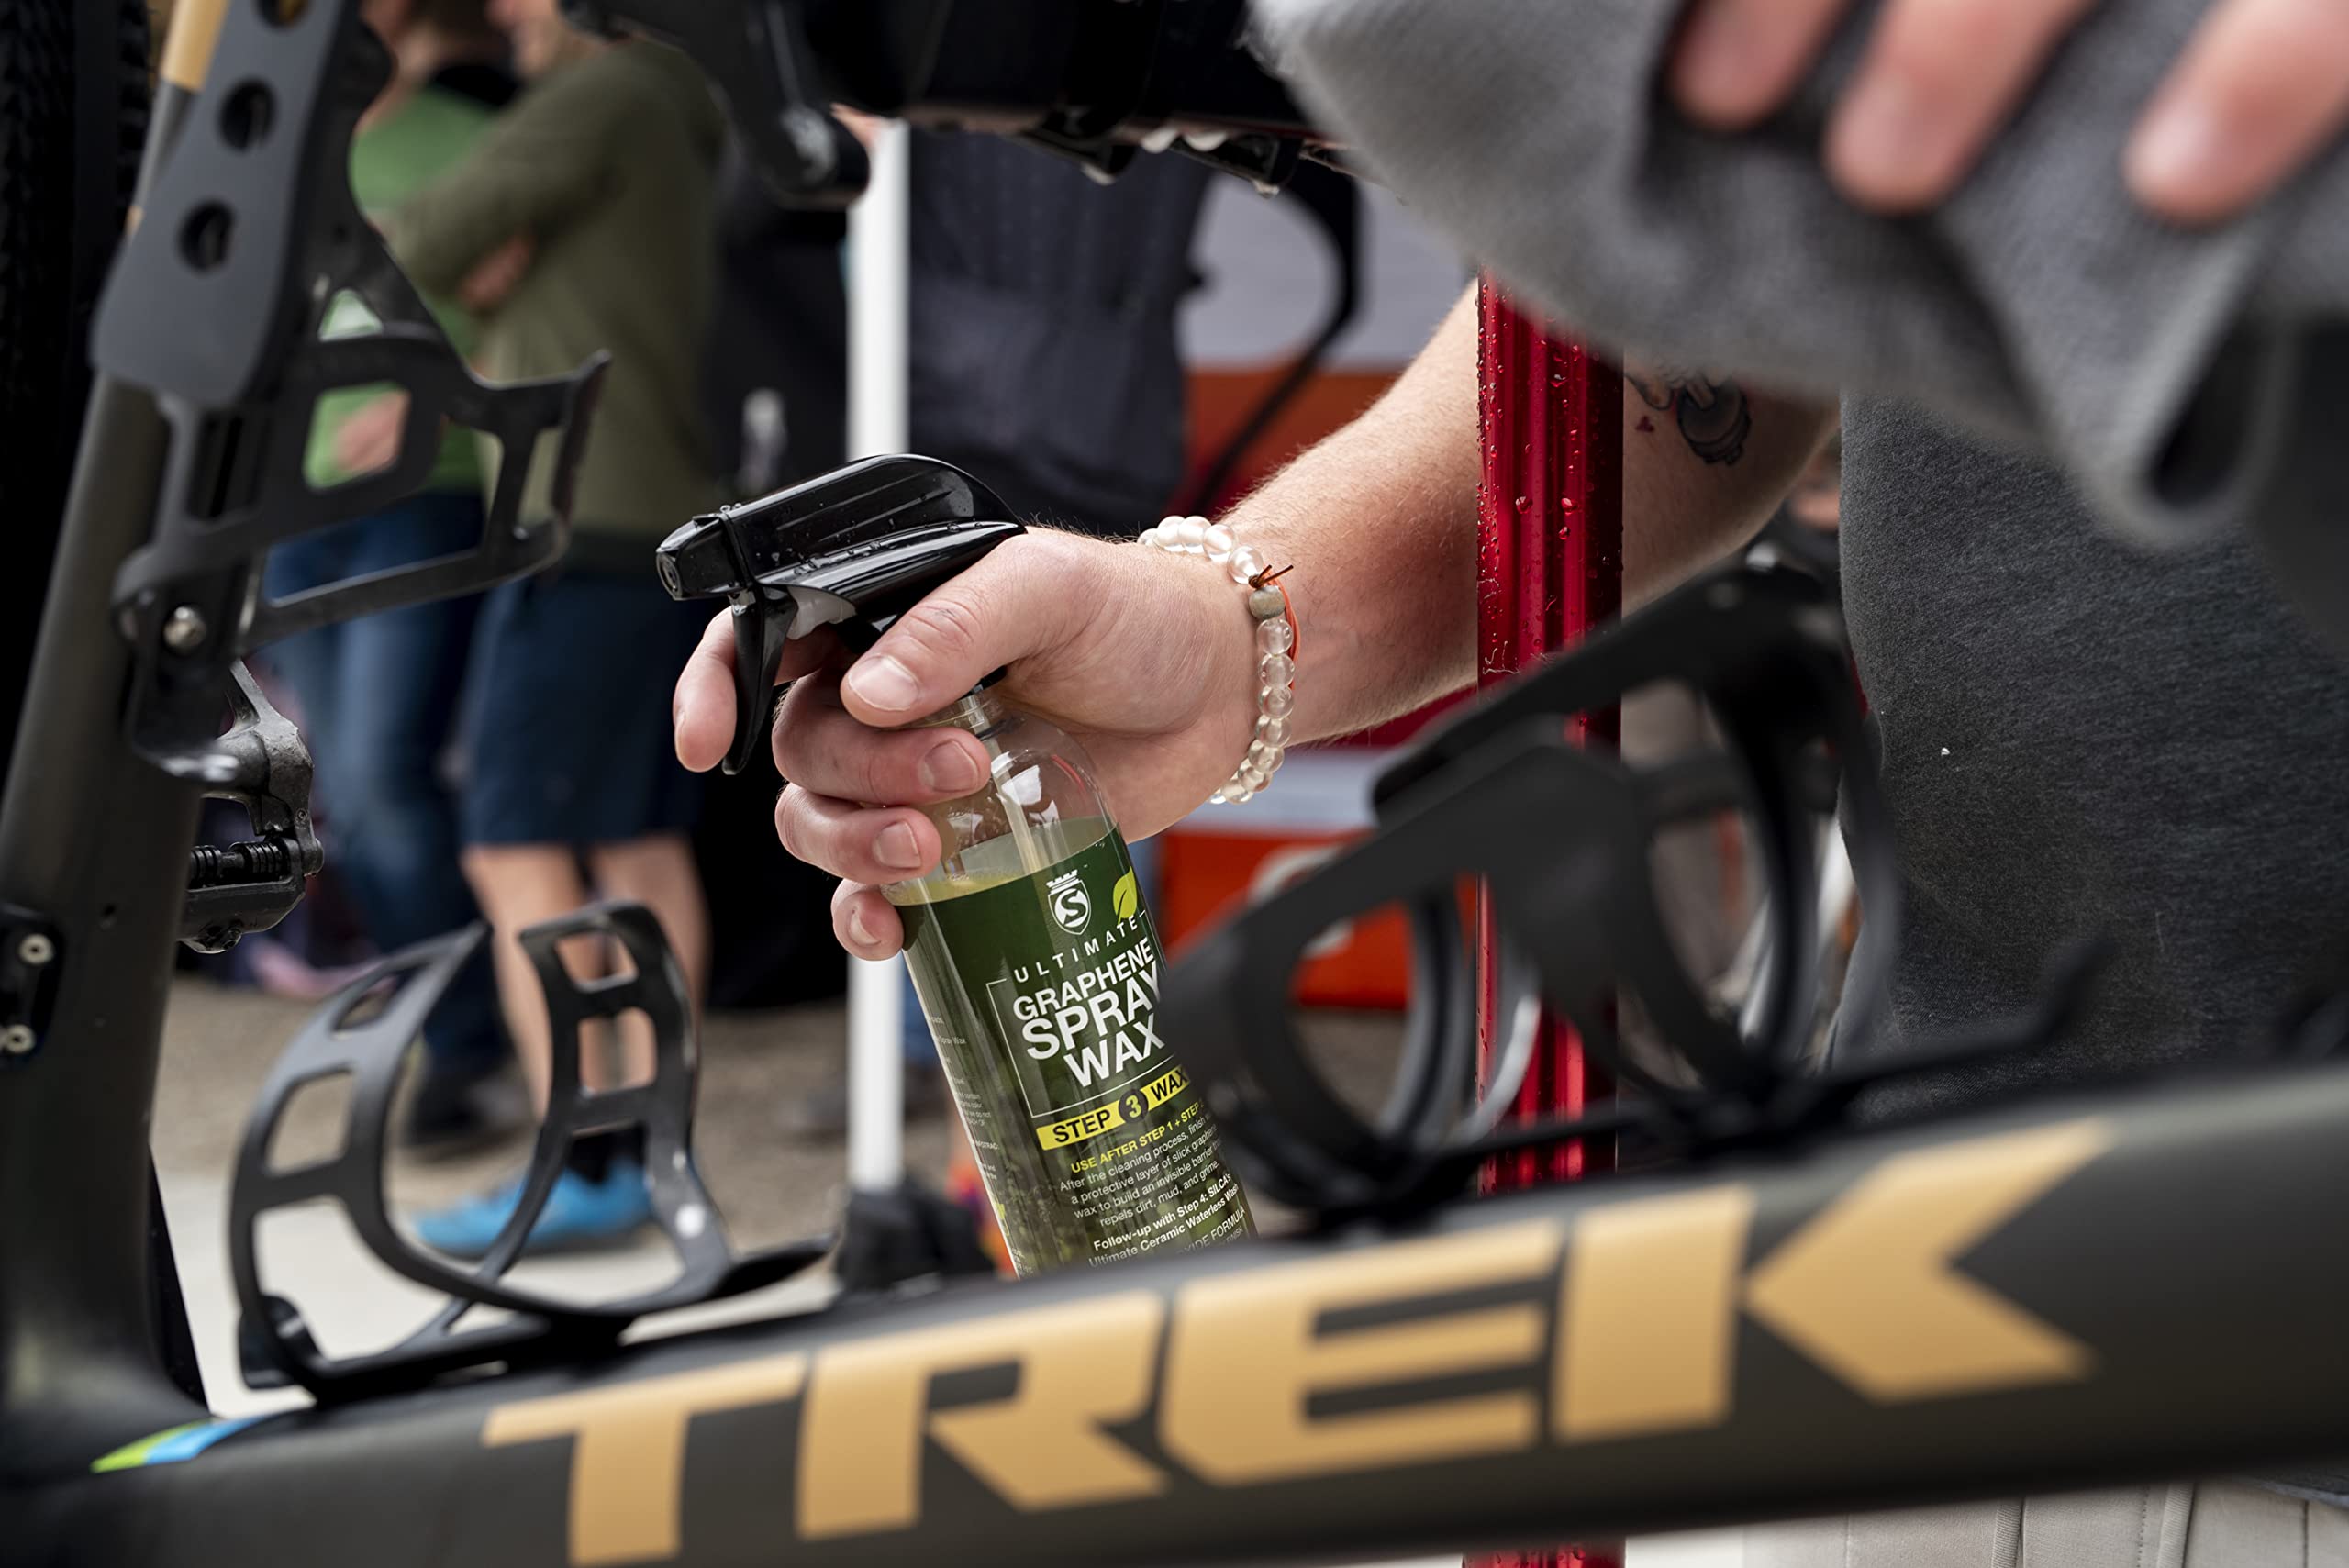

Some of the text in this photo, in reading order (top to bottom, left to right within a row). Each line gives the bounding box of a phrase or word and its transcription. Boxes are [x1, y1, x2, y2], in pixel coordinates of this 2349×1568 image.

[1013, 937, 1154, 1021] GRAPHENE
[1014, 915, 1138, 983] ULTIMATE
[1022, 960, 1160, 1060] SPRAY
[1063, 1012, 1165, 1087] WAX
[1052, 1067, 1188, 1143] STEP 3 WAX
[1071, 1157, 1097, 1173] USE
[1100, 1140, 1138, 1164] AFTER
[1139, 1126, 1165, 1147] STEP
[1167, 1121, 1173, 1131] 1
[1181, 1102, 1199, 1123] STEP
[1060, 1178, 1085, 1192] After
[1087, 1172, 1106, 1184] the
[1108, 1151, 1152, 1176] cleaning
[1152, 1131, 1189, 1159] process,
[1188, 1116, 1206, 1135] finish
[1071, 1195, 1079, 1205] a
[1081, 1176, 1134, 1204] protective
[1135, 1162, 1160, 1182] layer
[1162, 1156, 1171, 1169] of
[1173, 1145, 1191, 1162] slick
[1074, 1207, 1097, 1218] wax
[1099, 1202, 1111, 1211] to
[1113, 1188, 1141, 1207] build
[1142, 1183, 1155, 1195] an
[1157, 1162, 1192, 1187] invisible
[1191, 1145, 1214, 1167] barrier
[1088, 1246, 1139, 1267] Ultimate
[1140, 1225, 1186, 1251] Ceramic
[1186, 1197, 1225, 1229] Waterless
[1224, 1183, 1239, 1201] Wash
[1094, 1225, 1152, 1251] Follow-up
[1153, 1212, 1176, 1229] with
[1177, 1200, 1199, 1218] Step
[1200, 1193, 1208, 1203] 4:
[1100, 1208, 1134, 1227] repels
[1136, 1198, 1156, 1213] dirt,
[1158, 1184, 1183, 1203] mud,
[1183, 1173, 1199, 1189] and
[1210, 1205, 1245, 1240] FORMULA
[482, 1119, 2113, 1565] TREK
